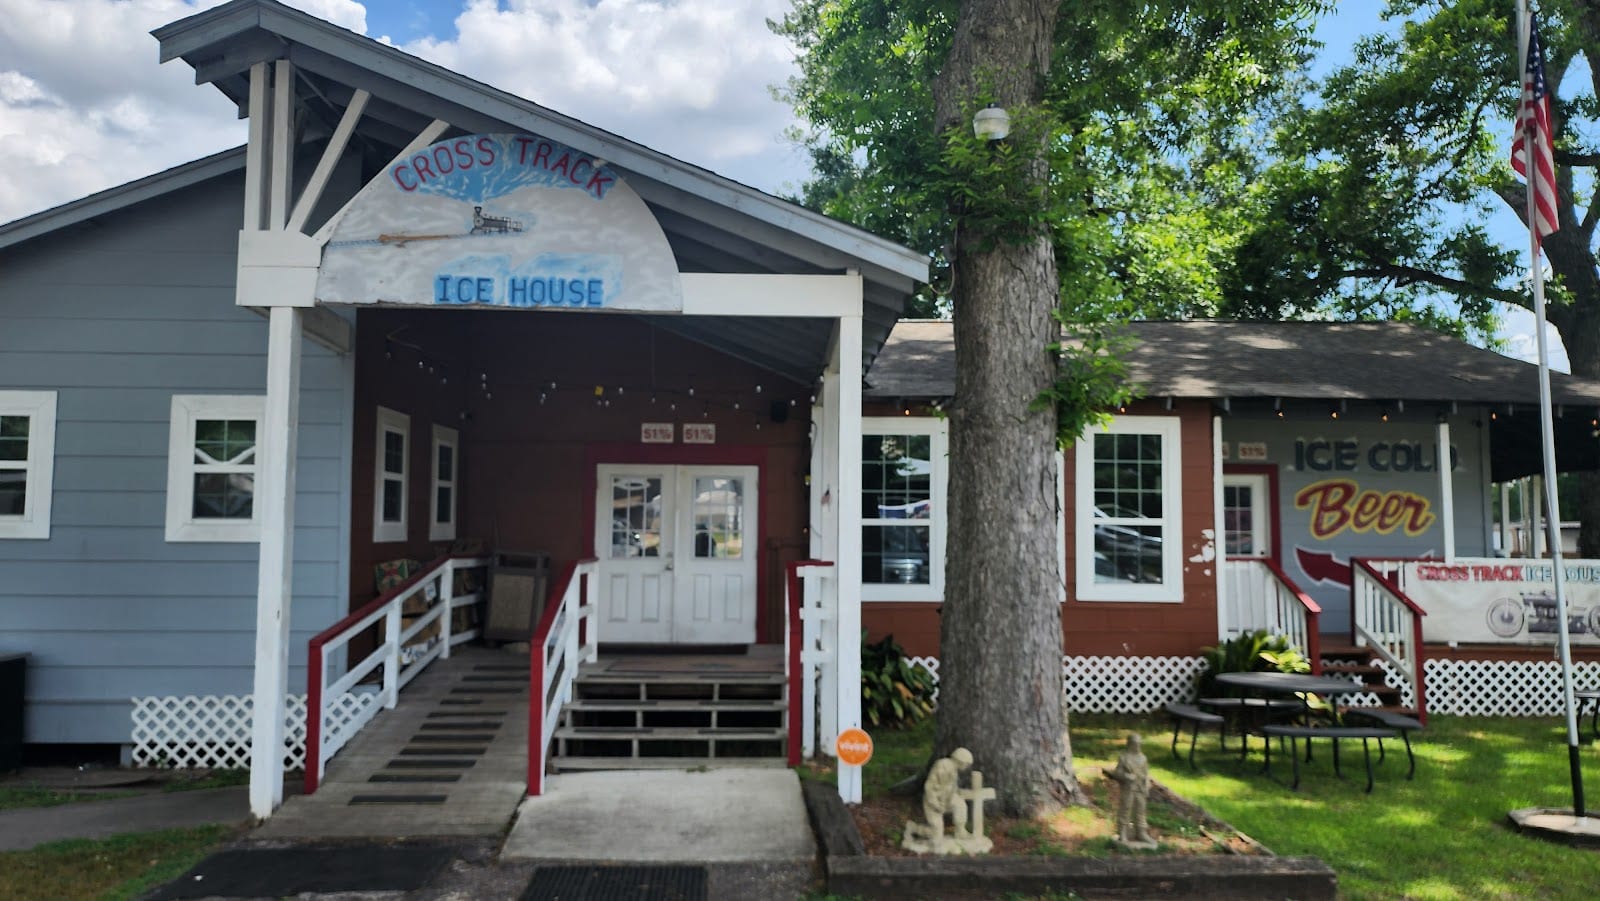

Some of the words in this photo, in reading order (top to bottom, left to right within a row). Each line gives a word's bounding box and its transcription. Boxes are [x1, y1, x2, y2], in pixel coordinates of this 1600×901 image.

[394, 138, 495, 192] CROSS
[516, 138, 613, 197] TRACK
[438, 277, 492, 303] ICE
[511, 279, 602, 305] HOUSE
[643, 428, 672, 440] 51%
[685, 428, 713, 440] 51%
[1294, 441, 1360, 472] ICE
[1295, 479, 1435, 540] Beer
[1417, 565, 1469, 582] CROSS
[1471, 565, 1524, 582] TRACK
[1525, 565, 1552, 582] ICE
[1563, 565, 1600, 583] OUS
